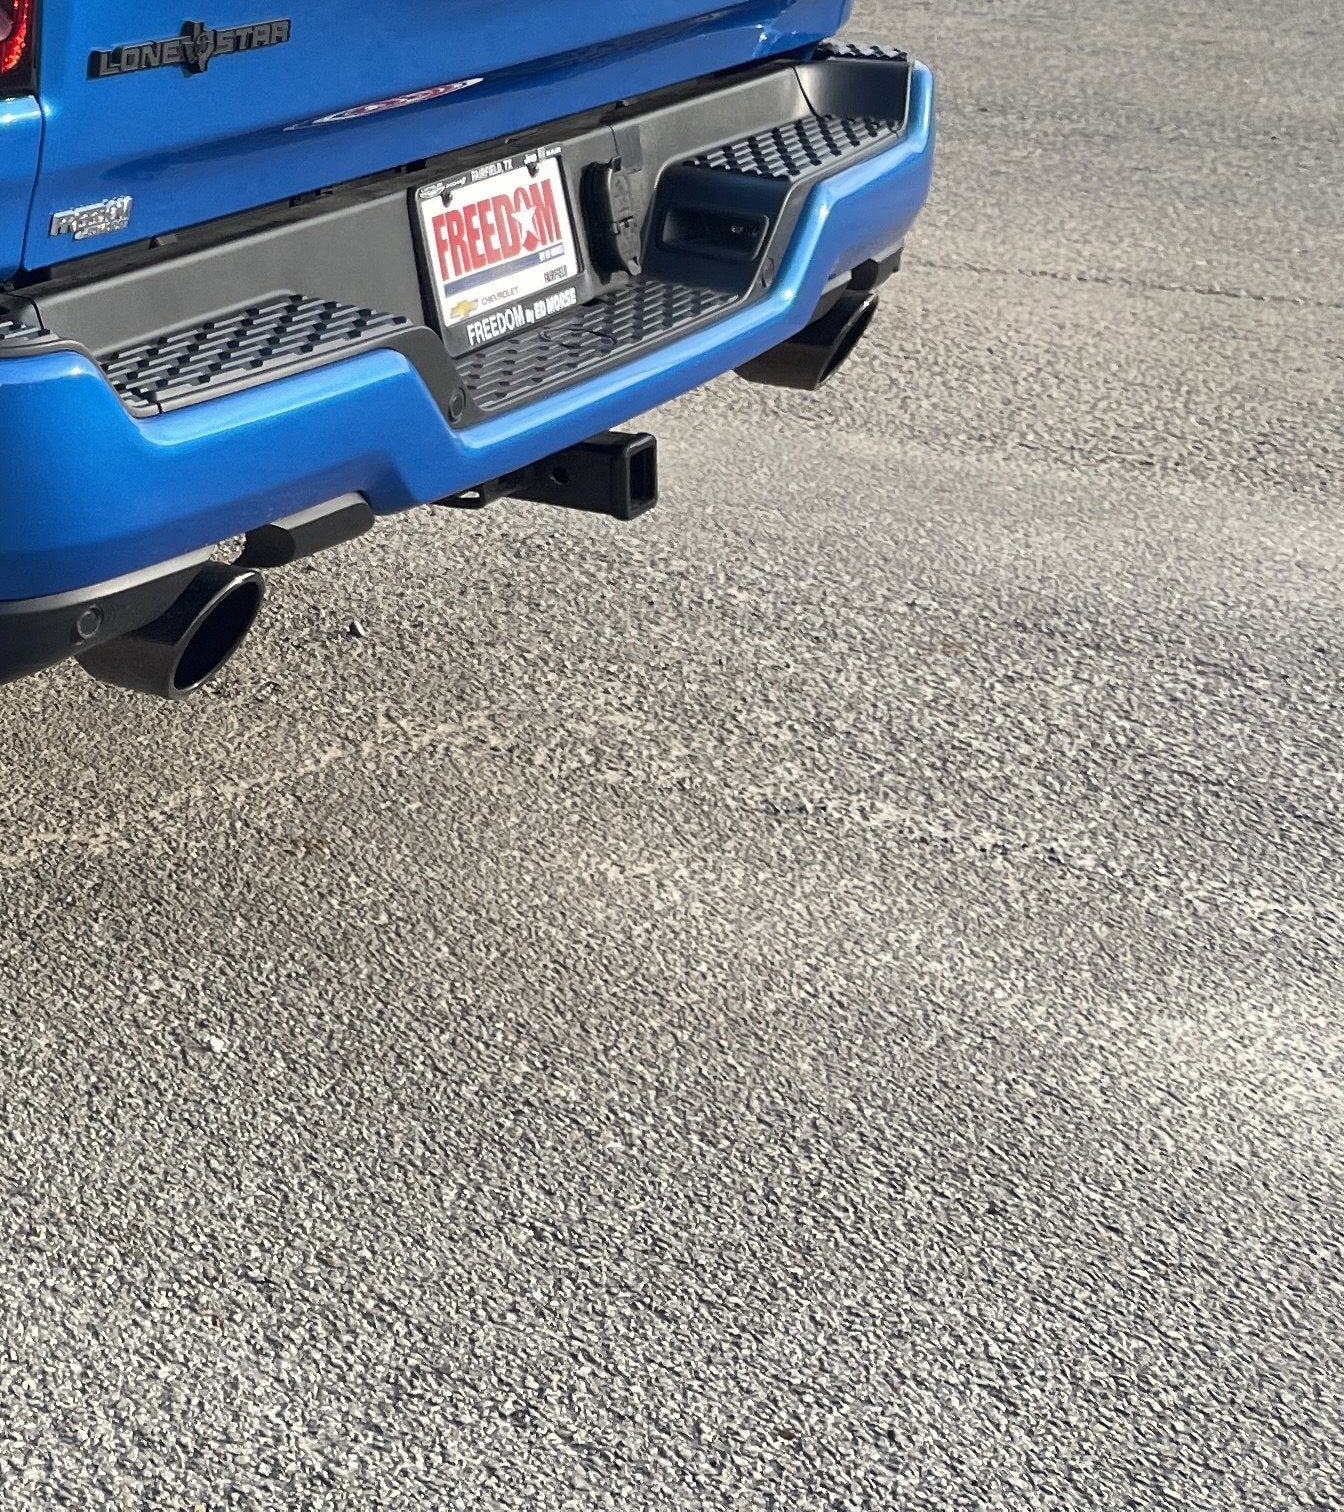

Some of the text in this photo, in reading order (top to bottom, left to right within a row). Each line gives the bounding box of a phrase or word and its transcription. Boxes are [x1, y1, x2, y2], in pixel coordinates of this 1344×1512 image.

[97, 18, 291, 77] LONE STAR
[432, 179, 562, 281] FREEDOM
[466, 304, 526, 346] FREEDOM
[533, 300, 547, 320] ED
[545, 287, 577, 315] MORSE
[481, 286, 519, 306] CHEVROLET
